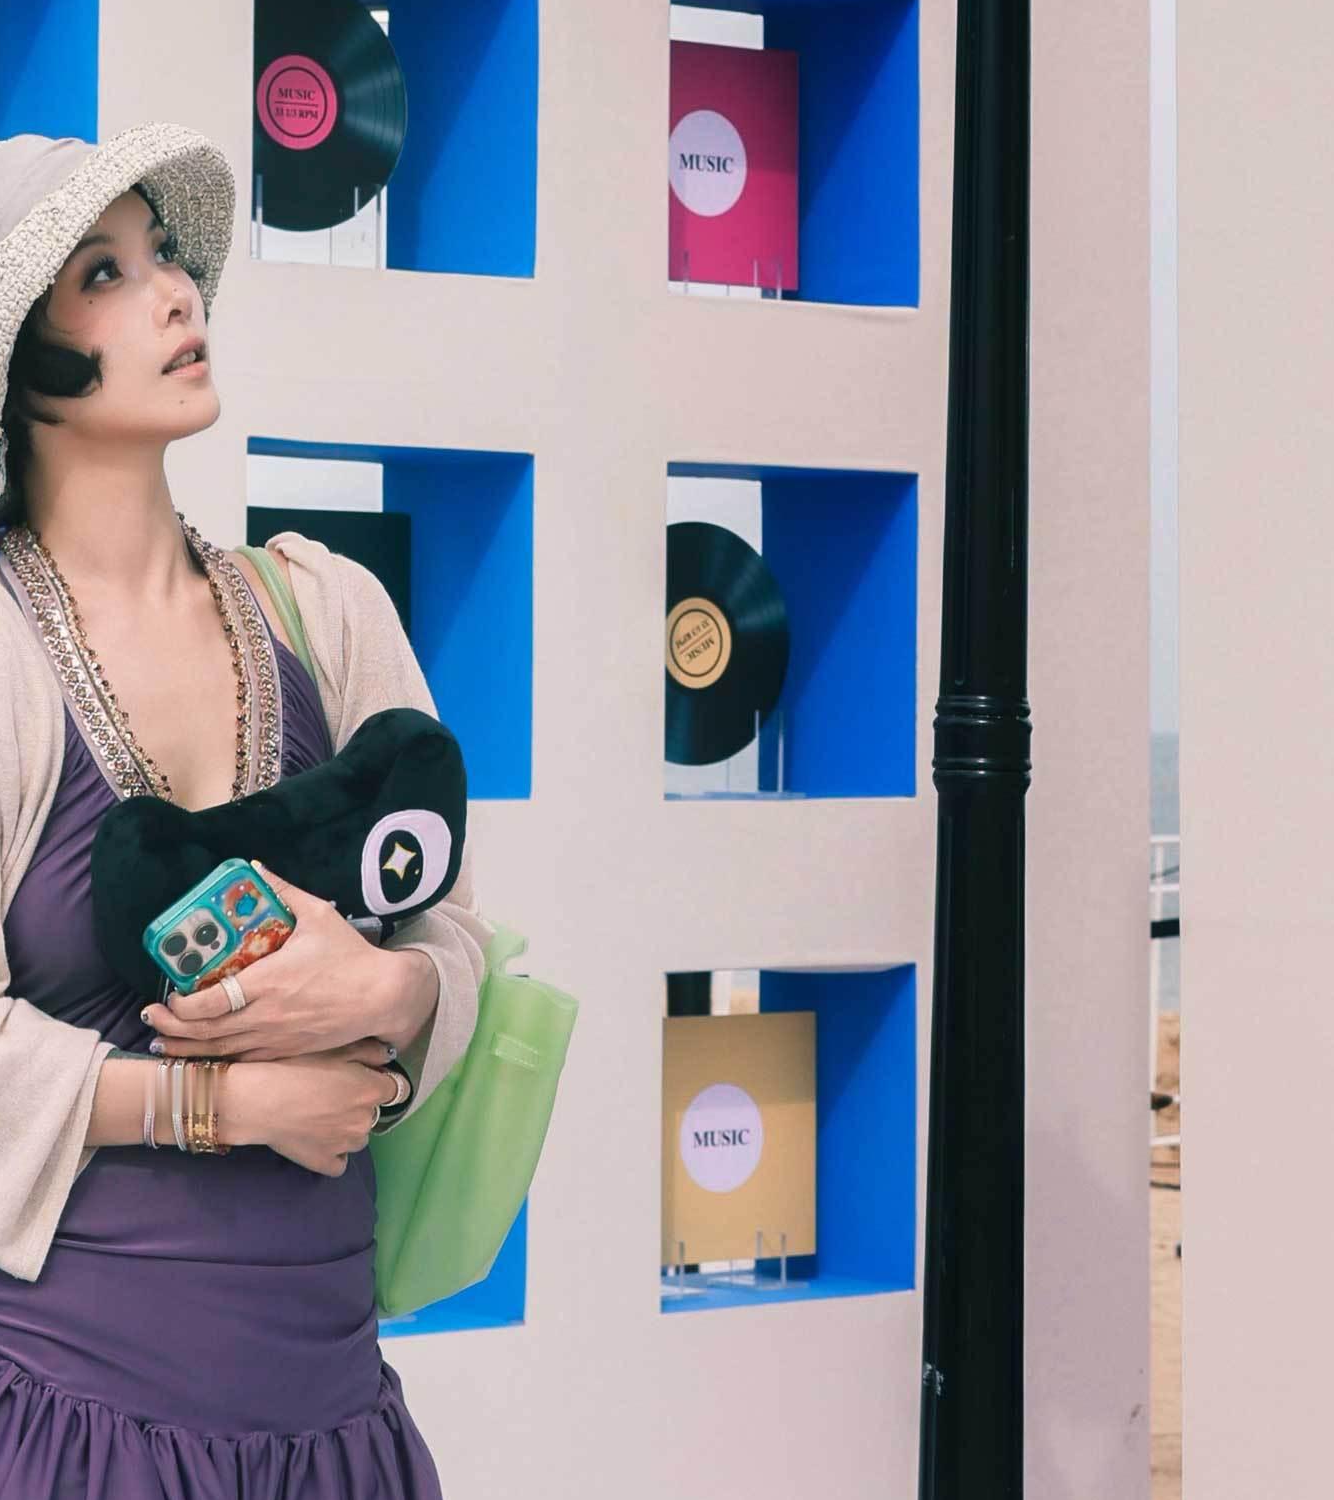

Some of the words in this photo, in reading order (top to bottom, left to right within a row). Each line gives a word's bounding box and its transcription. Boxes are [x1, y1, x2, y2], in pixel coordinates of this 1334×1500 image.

[278, 87, 316, 101] MUSIC
[679, 152, 735, 175] MUSIC
[693, 1128, 751, 1149] MUSIC
